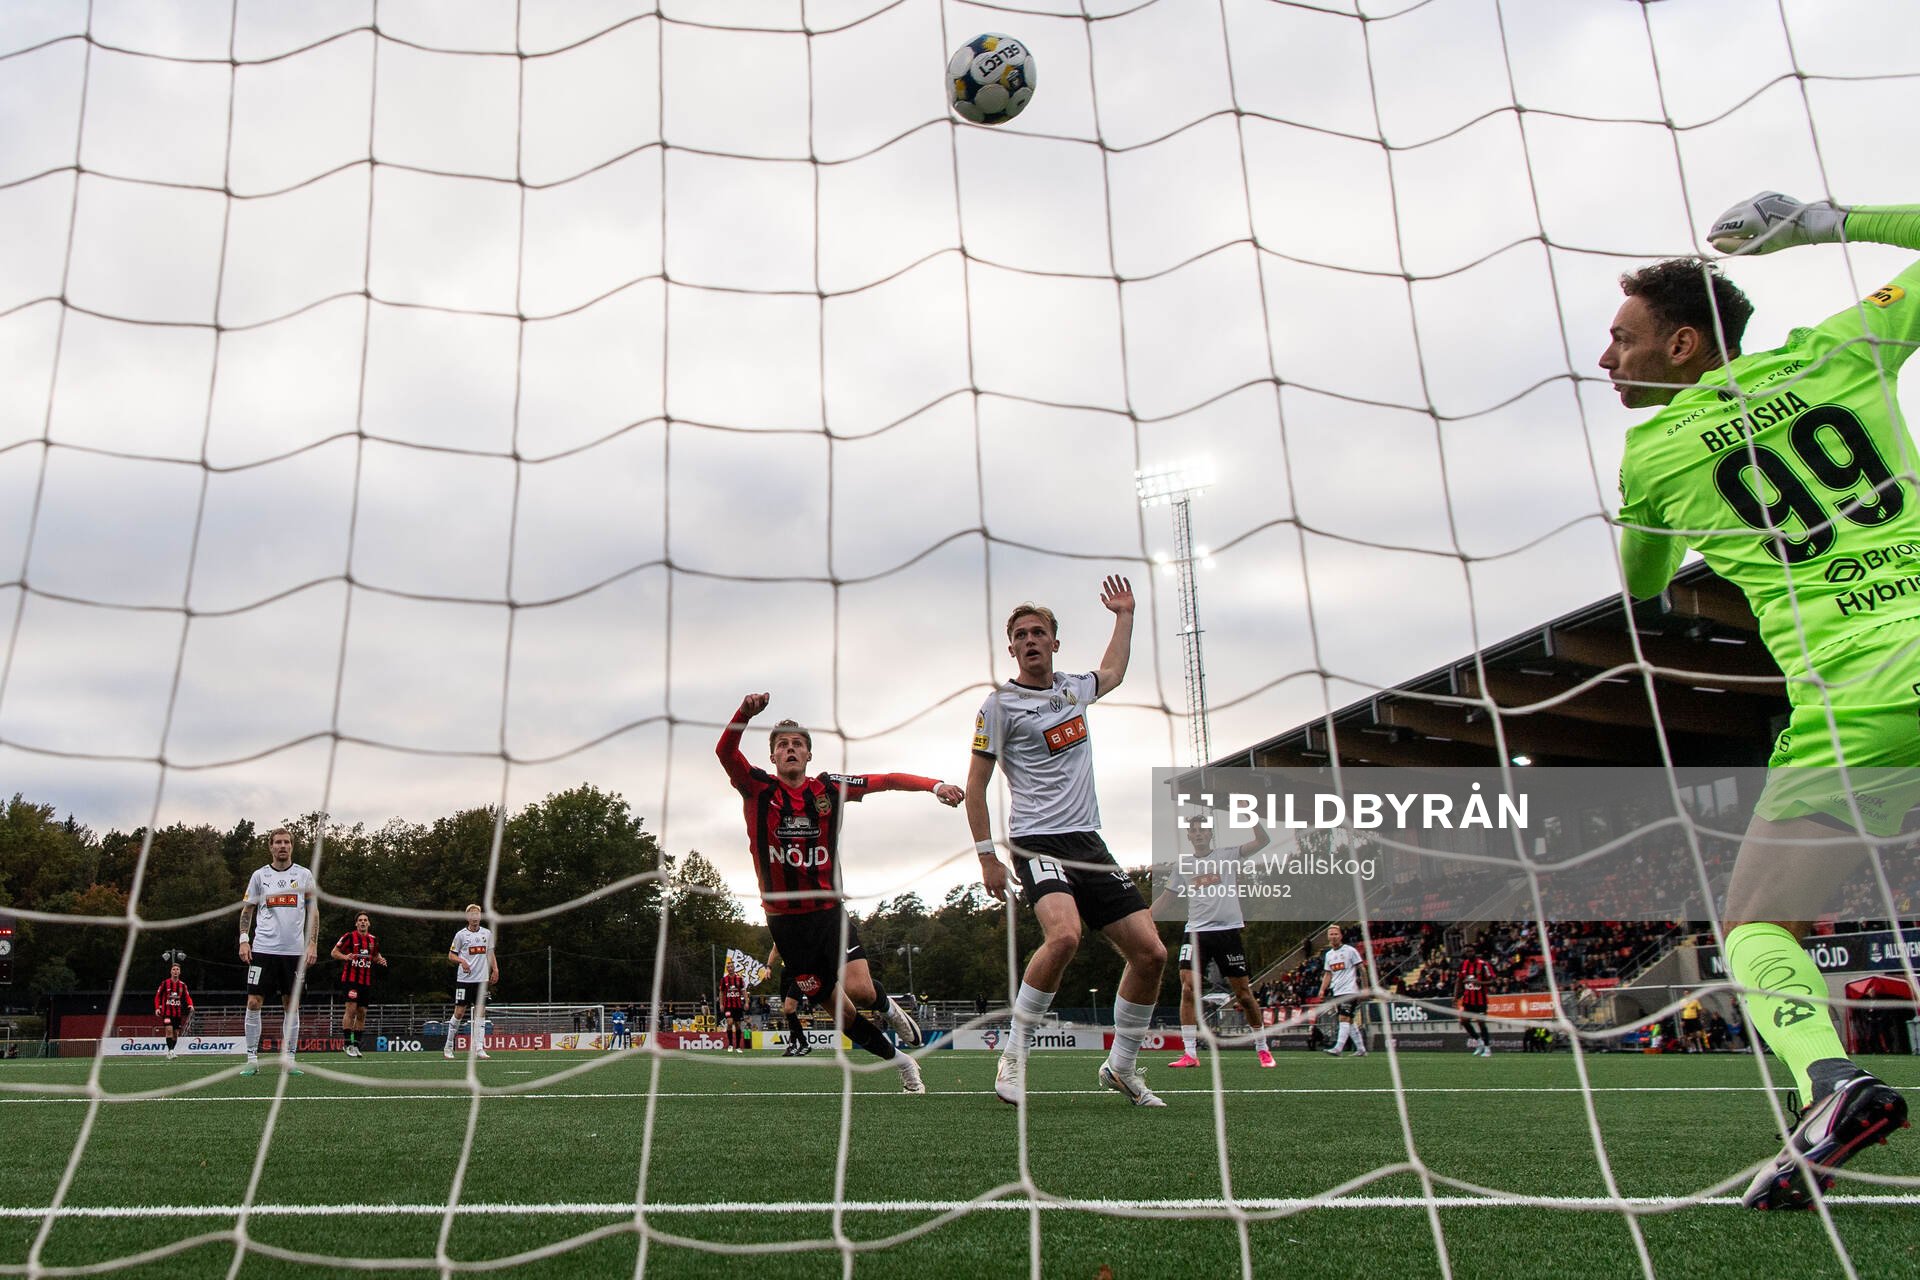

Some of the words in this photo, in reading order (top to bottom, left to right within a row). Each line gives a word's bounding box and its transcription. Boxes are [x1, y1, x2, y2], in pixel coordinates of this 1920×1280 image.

[979, 43, 1020, 77] SELECT
[1667, 407, 1707, 437] SANKT
[1700, 391, 1810, 453] BERISHA
[1713, 402, 1905, 565] 99
[1051, 722, 1086, 744] BRA
[769, 843, 829, 867] NÖJD
[121, 1040, 167, 1051] GIGANT
[188, 1040, 235, 1051] GIGANT
[457, 1036, 544, 1049] BUHAUS
